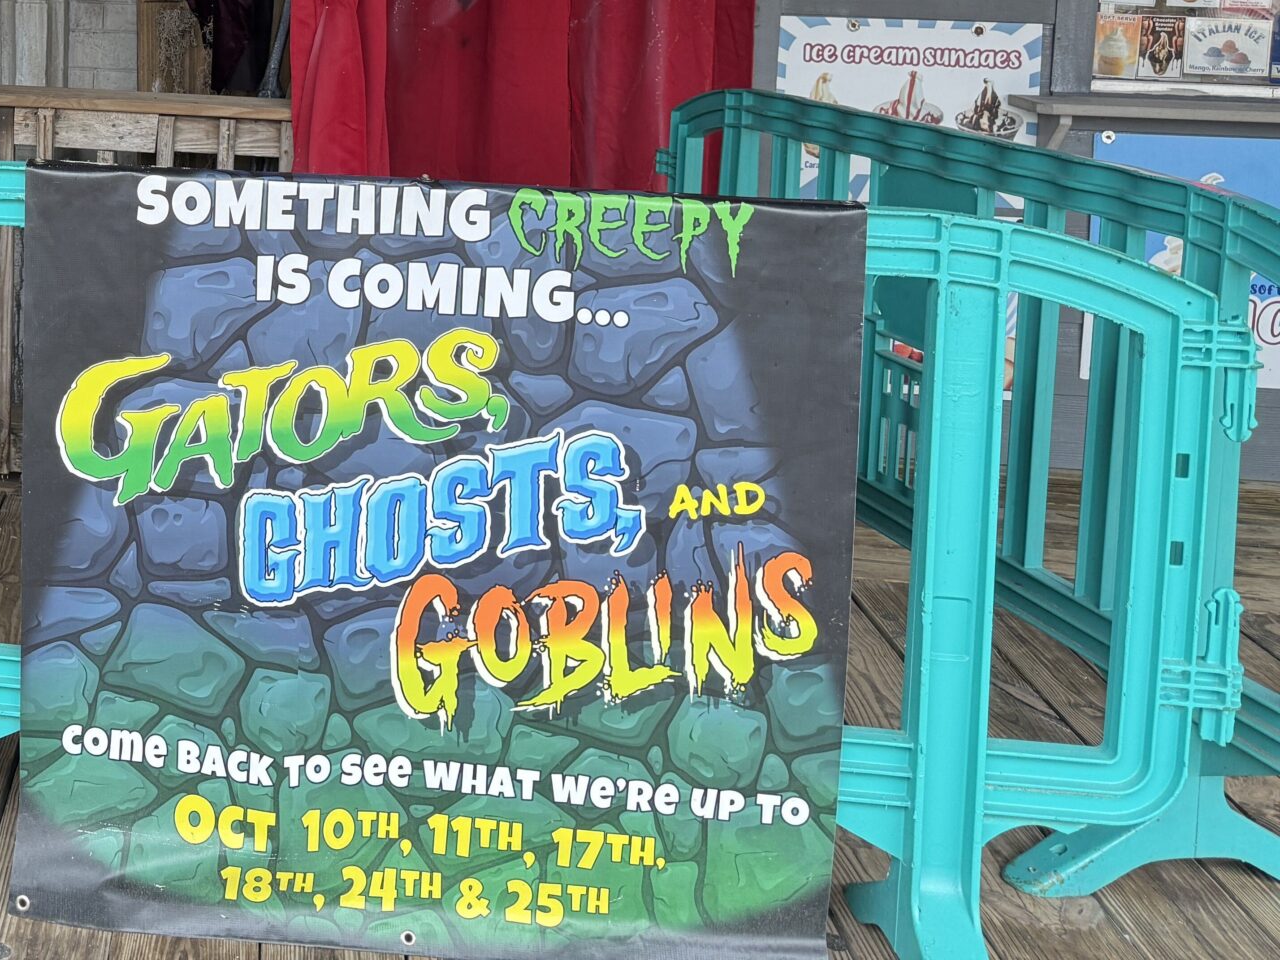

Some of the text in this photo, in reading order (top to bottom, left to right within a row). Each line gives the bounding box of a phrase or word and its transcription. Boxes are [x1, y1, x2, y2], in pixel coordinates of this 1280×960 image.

[803, 42, 1022, 69] Ice cream sundaes
[1245, 25, 1266, 44] ICE
[1245, 66, 1265, 74] Cherry
[136, 174, 756, 279] SOMETHING CREEPY
[255, 252, 630, 329] IS COMING...
[56, 326, 511, 507] GATORS,
[237, 427, 766, 611] GHOSTS, AND
[390, 541, 819, 732] GOBLINS
[176, 738, 275, 787] BACK
[283, 753, 332, 788] TO
[422, 759, 541, 801] WHAT
[756, 792, 811, 827] TO
[338, 864, 443, 913] 24TH
[454, 876, 491, 920] &
[504, 879, 611, 928] 25TH
